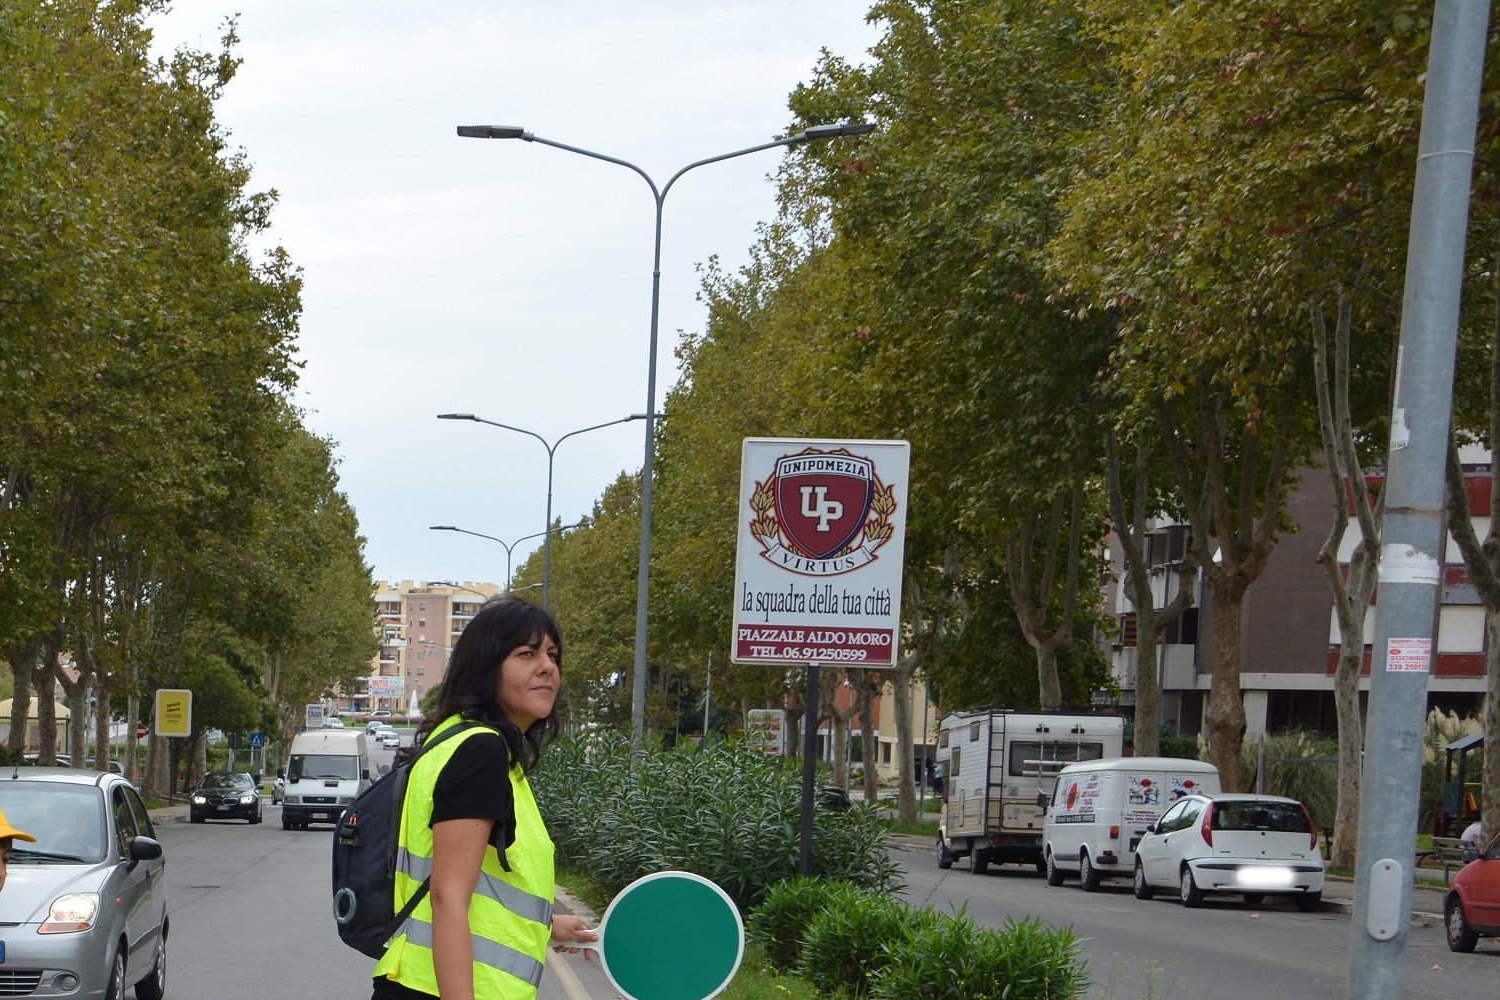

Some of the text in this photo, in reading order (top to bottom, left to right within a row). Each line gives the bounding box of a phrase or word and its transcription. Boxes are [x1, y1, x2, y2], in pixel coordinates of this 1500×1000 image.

[783, 460, 866, 476] UNIPOMEZIA
[783, 553, 855, 573] VIRTUS
[742, 582, 891, 622] la squadra della tua città
[738, 629, 890, 646] PIAZZALE ALDO MORO
[750, 646, 867, 661] TEL.06.91250599
